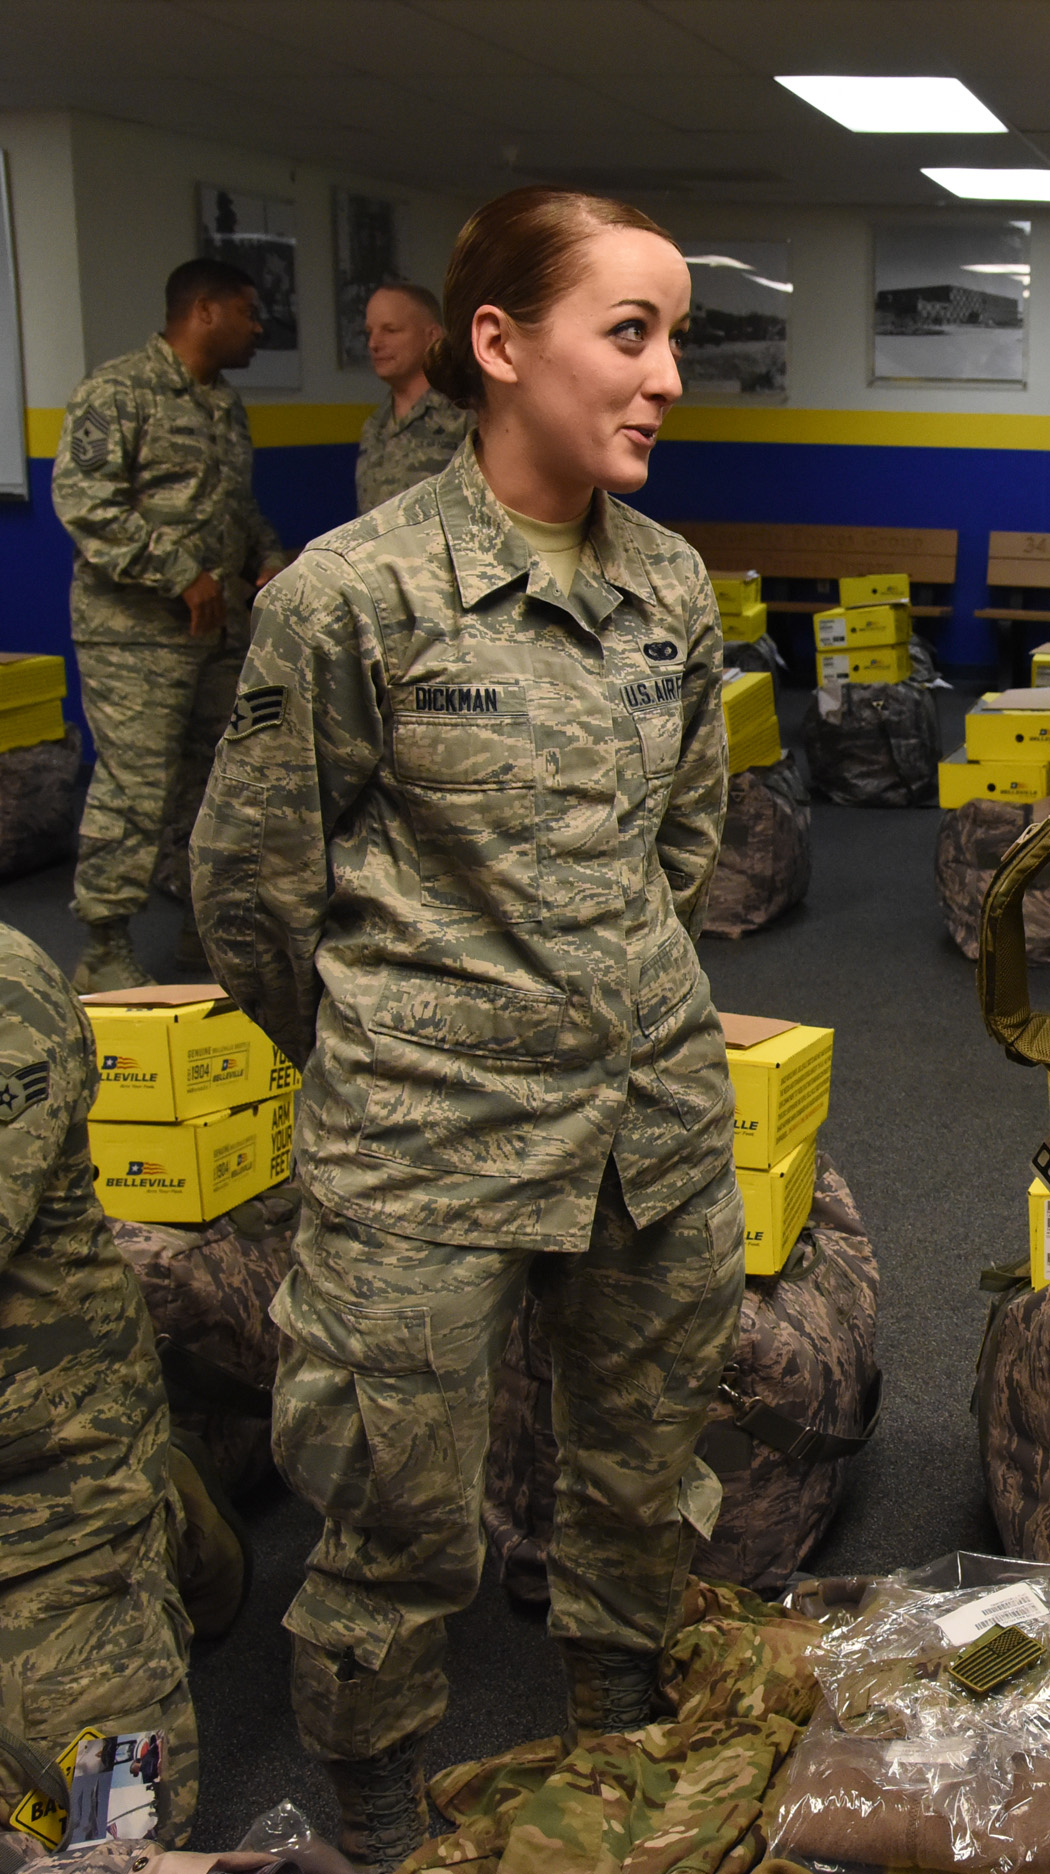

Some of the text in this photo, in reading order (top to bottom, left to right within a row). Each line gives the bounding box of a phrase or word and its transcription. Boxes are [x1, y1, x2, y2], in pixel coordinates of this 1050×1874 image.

[415, 686, 498, 712] DICKMAN
[624, 684, 654, 707] U.S.
[99, 1072, 158, 1082] LLEVILLE
[191, 1063, 209, 1081] 1904
[271, 1101, 290, 1130] ARM
[271, 1125, 292, 1154] YOUR
[106, 1178, 186, 1188] BELLEVILLE
